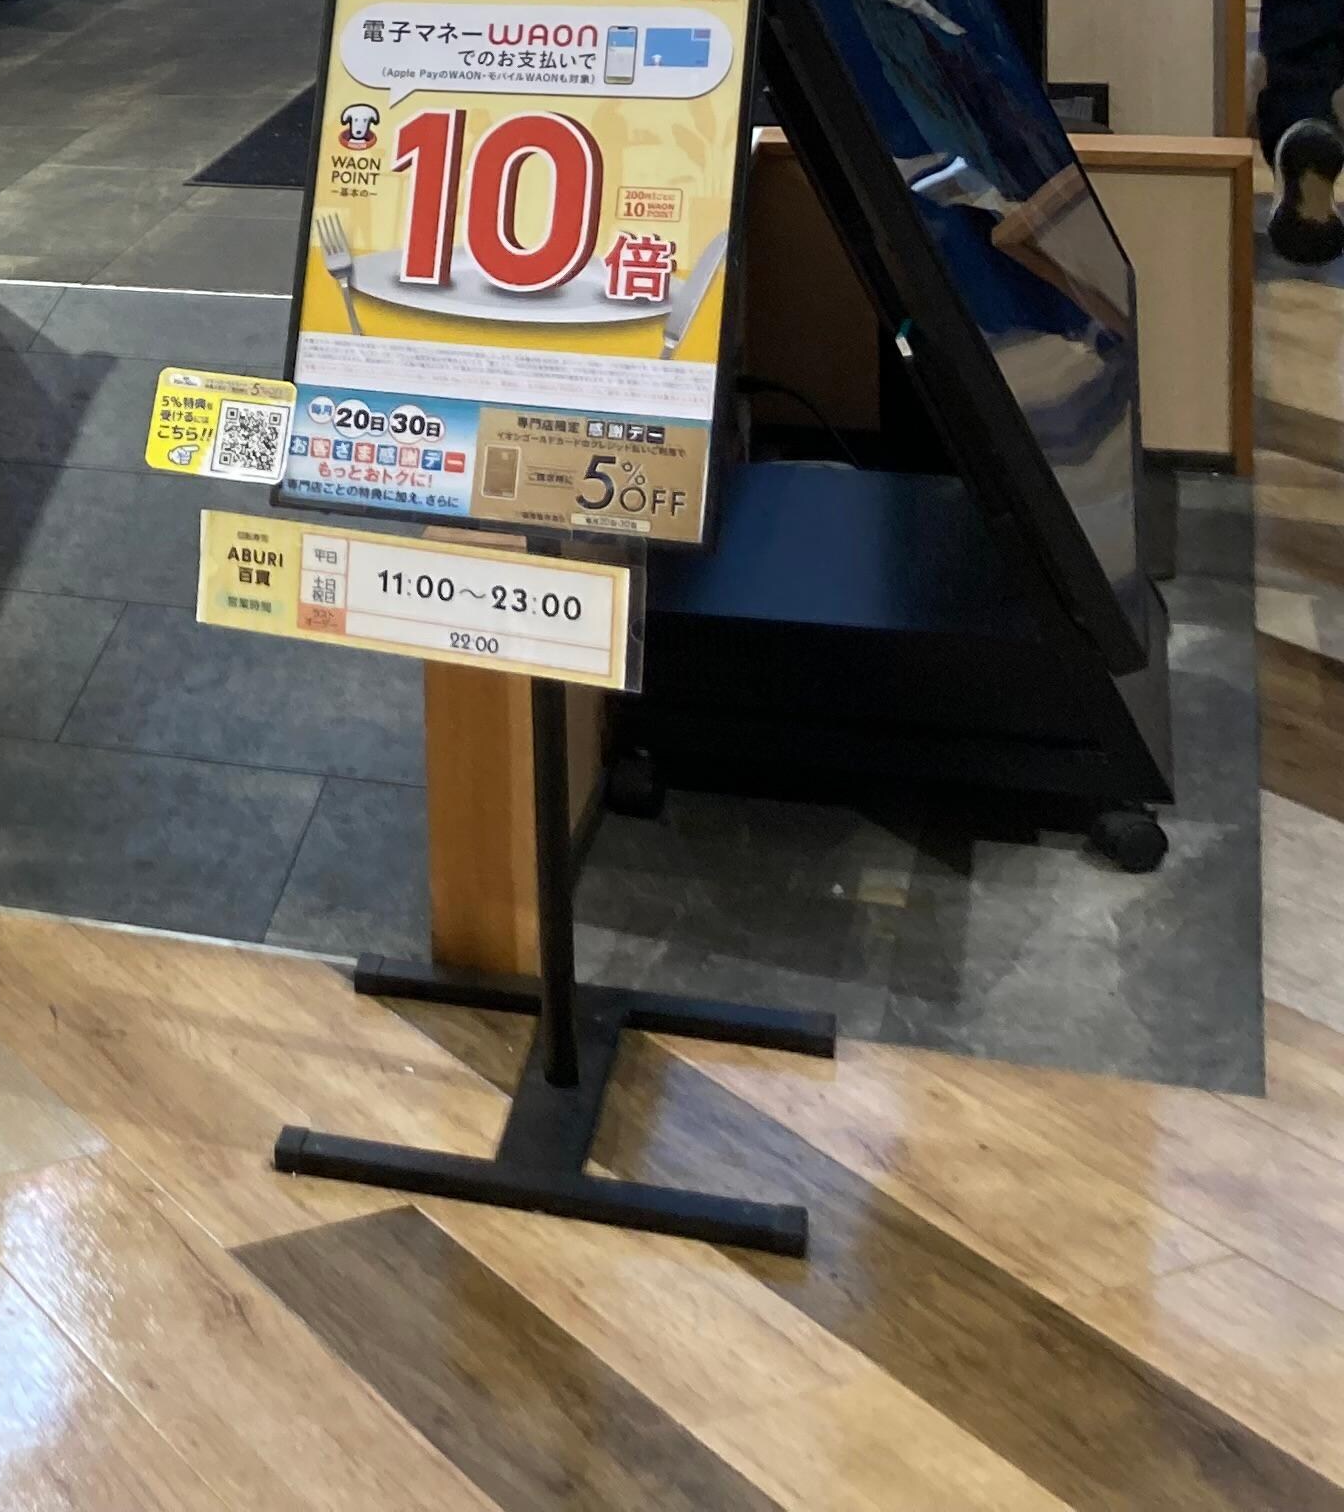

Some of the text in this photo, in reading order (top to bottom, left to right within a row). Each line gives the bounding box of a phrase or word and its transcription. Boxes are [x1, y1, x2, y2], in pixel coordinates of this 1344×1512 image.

[458, 50, 596, 70] でのお支払いで
[331, 155, 381, 170] WAON
[331, 171, 379, 186] POINT
[623, 202, 645, 218] 10
[311, 404, 441, 438] 毎月 20日 30日
[517, 416, 665, 445] 専門店限定 感謝デー
[157, 425, 214, 441] こちら!!
[289, 435, 466, 473] お客さま感謝デー
[318, 461, 433, 488] もっとおトクに!
[228, 546, 284, 569] ABURI
[313, 548, 338, 565] 平日
[238, 566, 271, 587] 百貫
[313, 576, 337, 591] 土日
[226, 594, 272, 614] 営業時間
[312, 589, 337, 606] 祝日
[449, 631, 500, 654] 22:00
